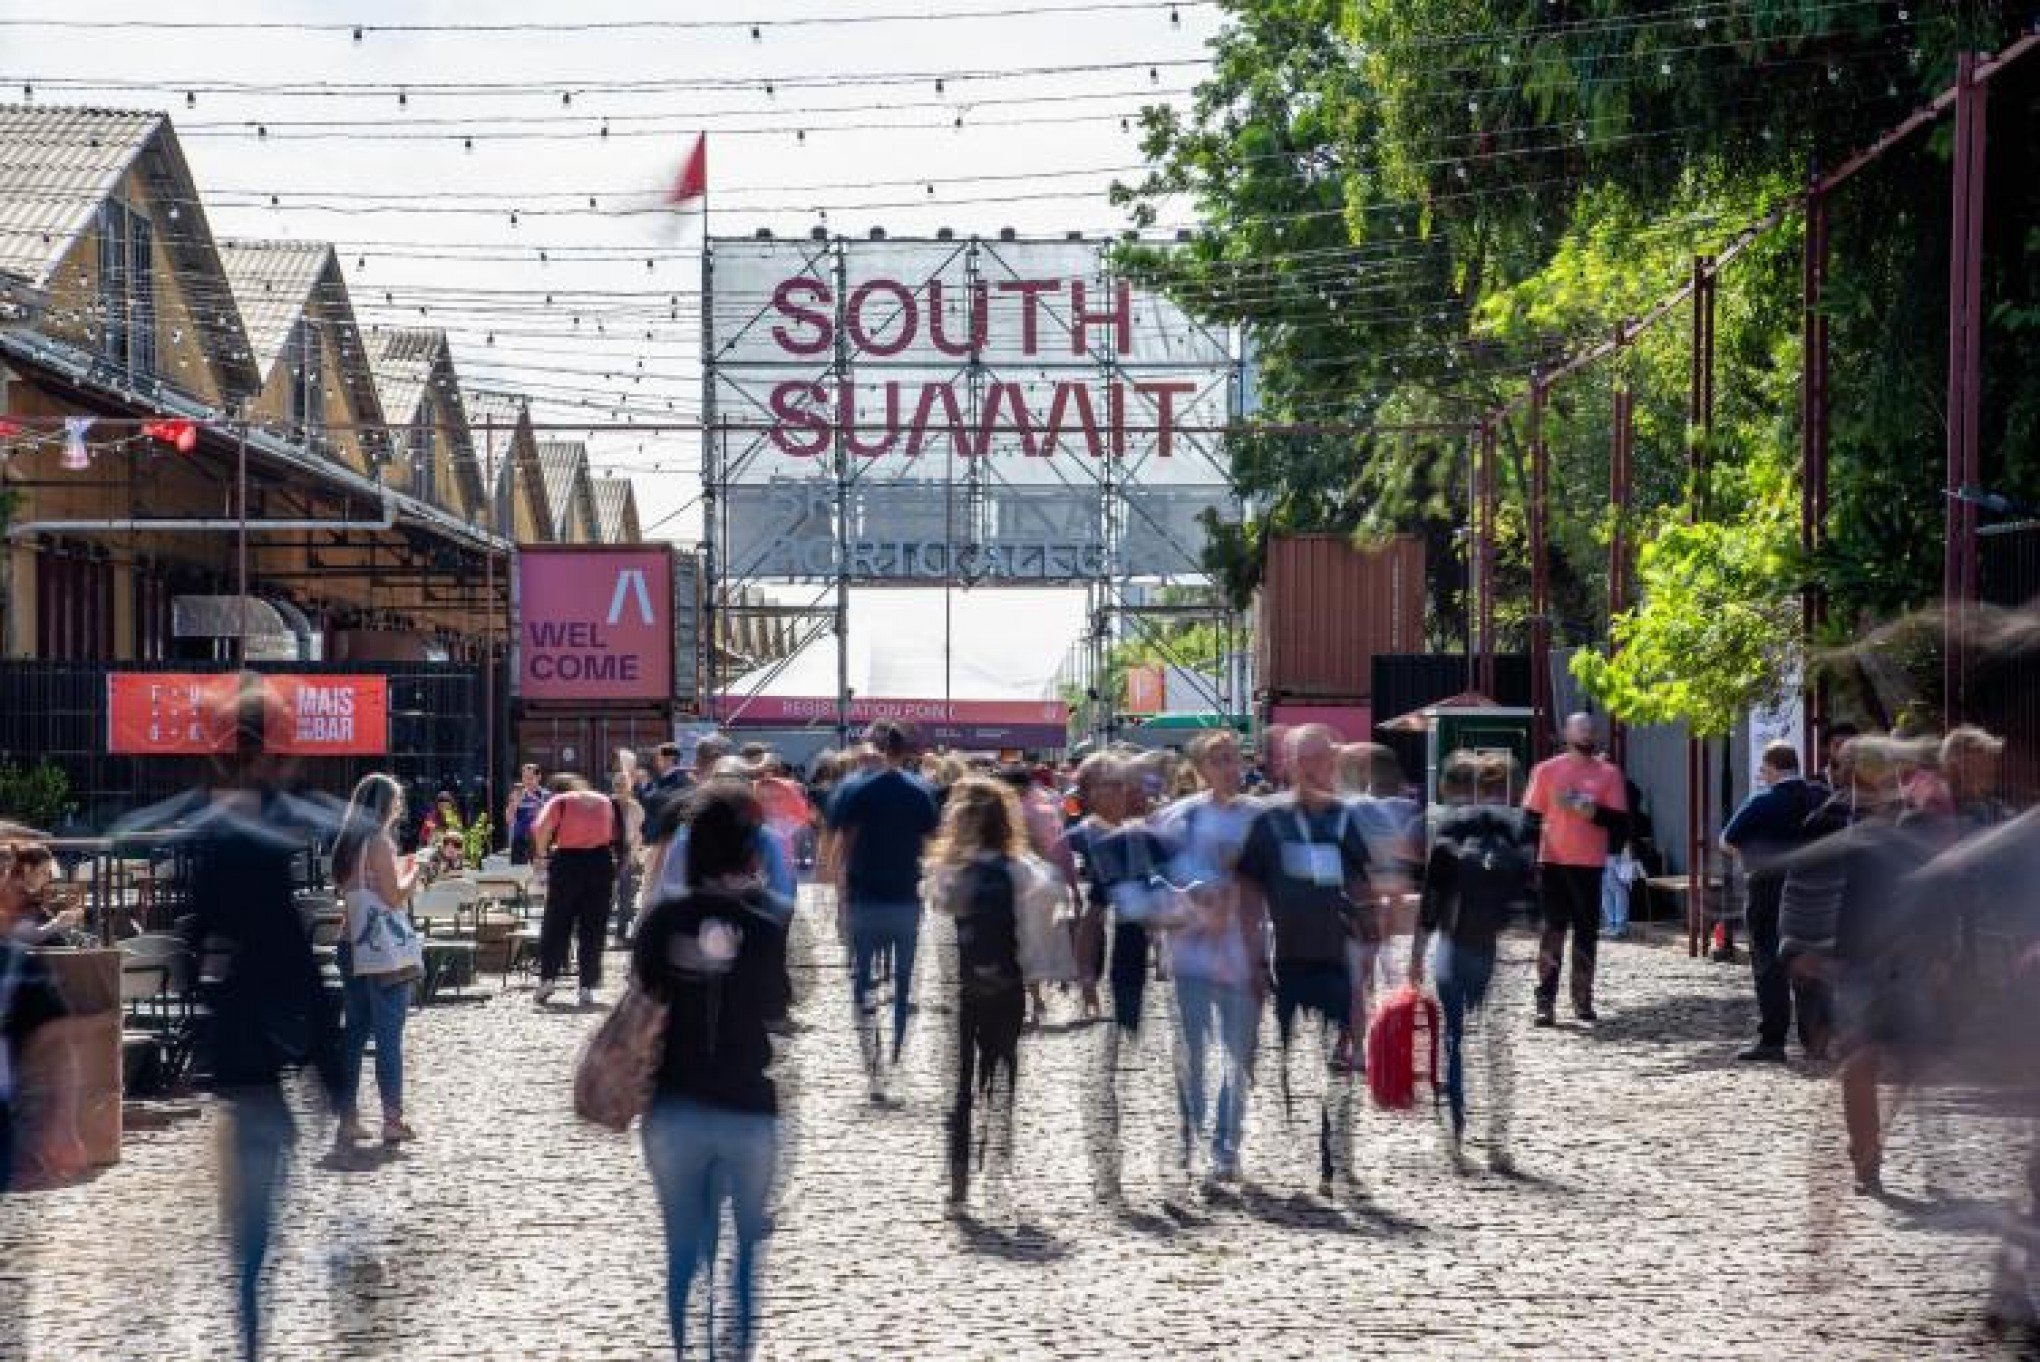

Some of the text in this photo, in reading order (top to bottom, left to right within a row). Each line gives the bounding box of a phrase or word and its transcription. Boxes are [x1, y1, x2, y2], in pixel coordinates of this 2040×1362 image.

[771, 276, 1132, 355] SOUTH
[770, 380, 1196, 458] SUMMIT
[530, 622, 608, 648] WEL
[530, 655, 639, 680] COME
[297, 686, 354, 715] MAIS
[315, 718, 354, 741] BAR
